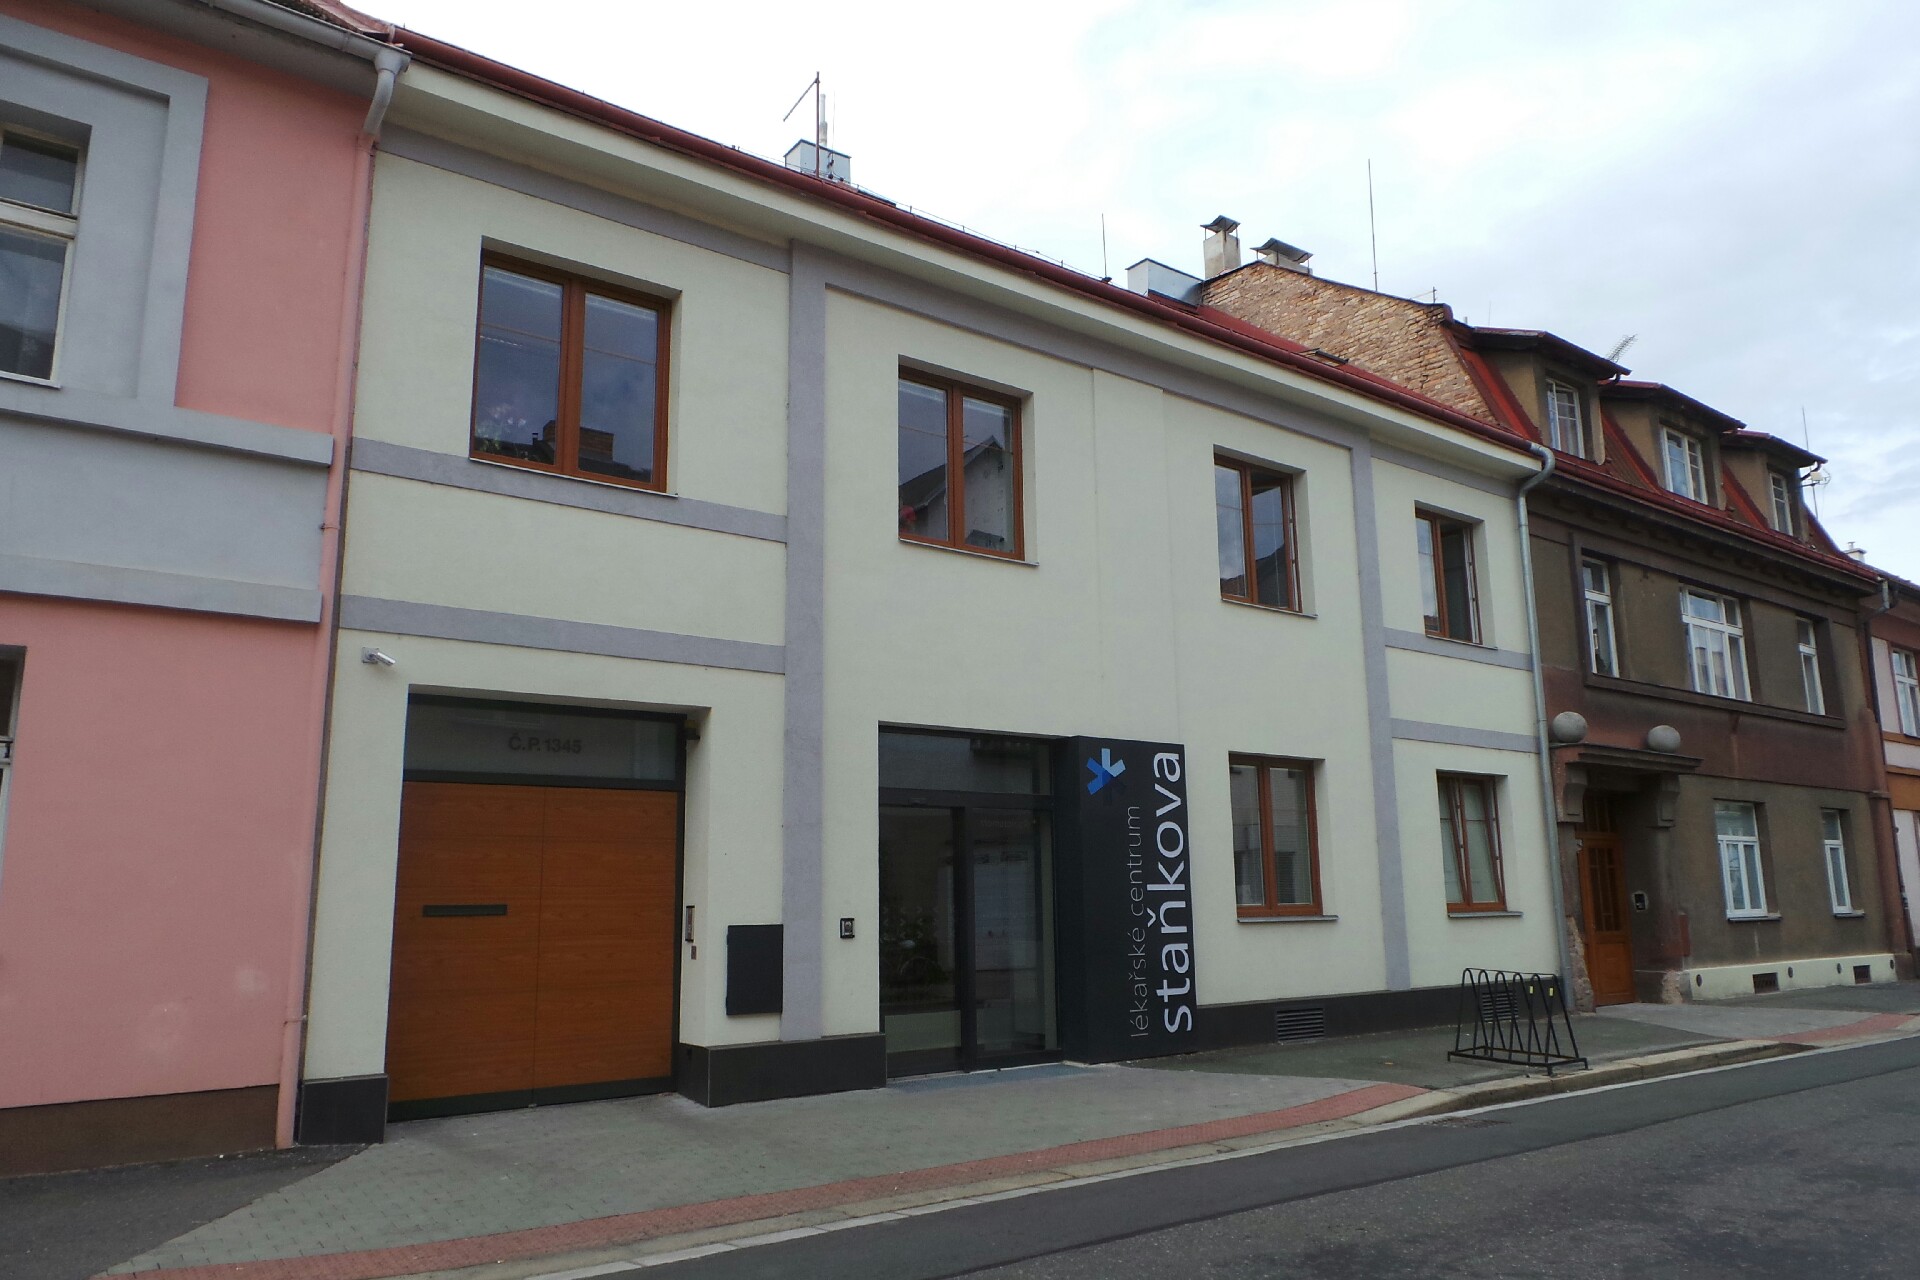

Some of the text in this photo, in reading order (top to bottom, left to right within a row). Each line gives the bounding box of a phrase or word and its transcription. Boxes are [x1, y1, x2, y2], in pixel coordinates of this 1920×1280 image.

[1126, 805, 1149, 1038] lékařské centrum
[1146, 752, 1193, 1033] staňkova
